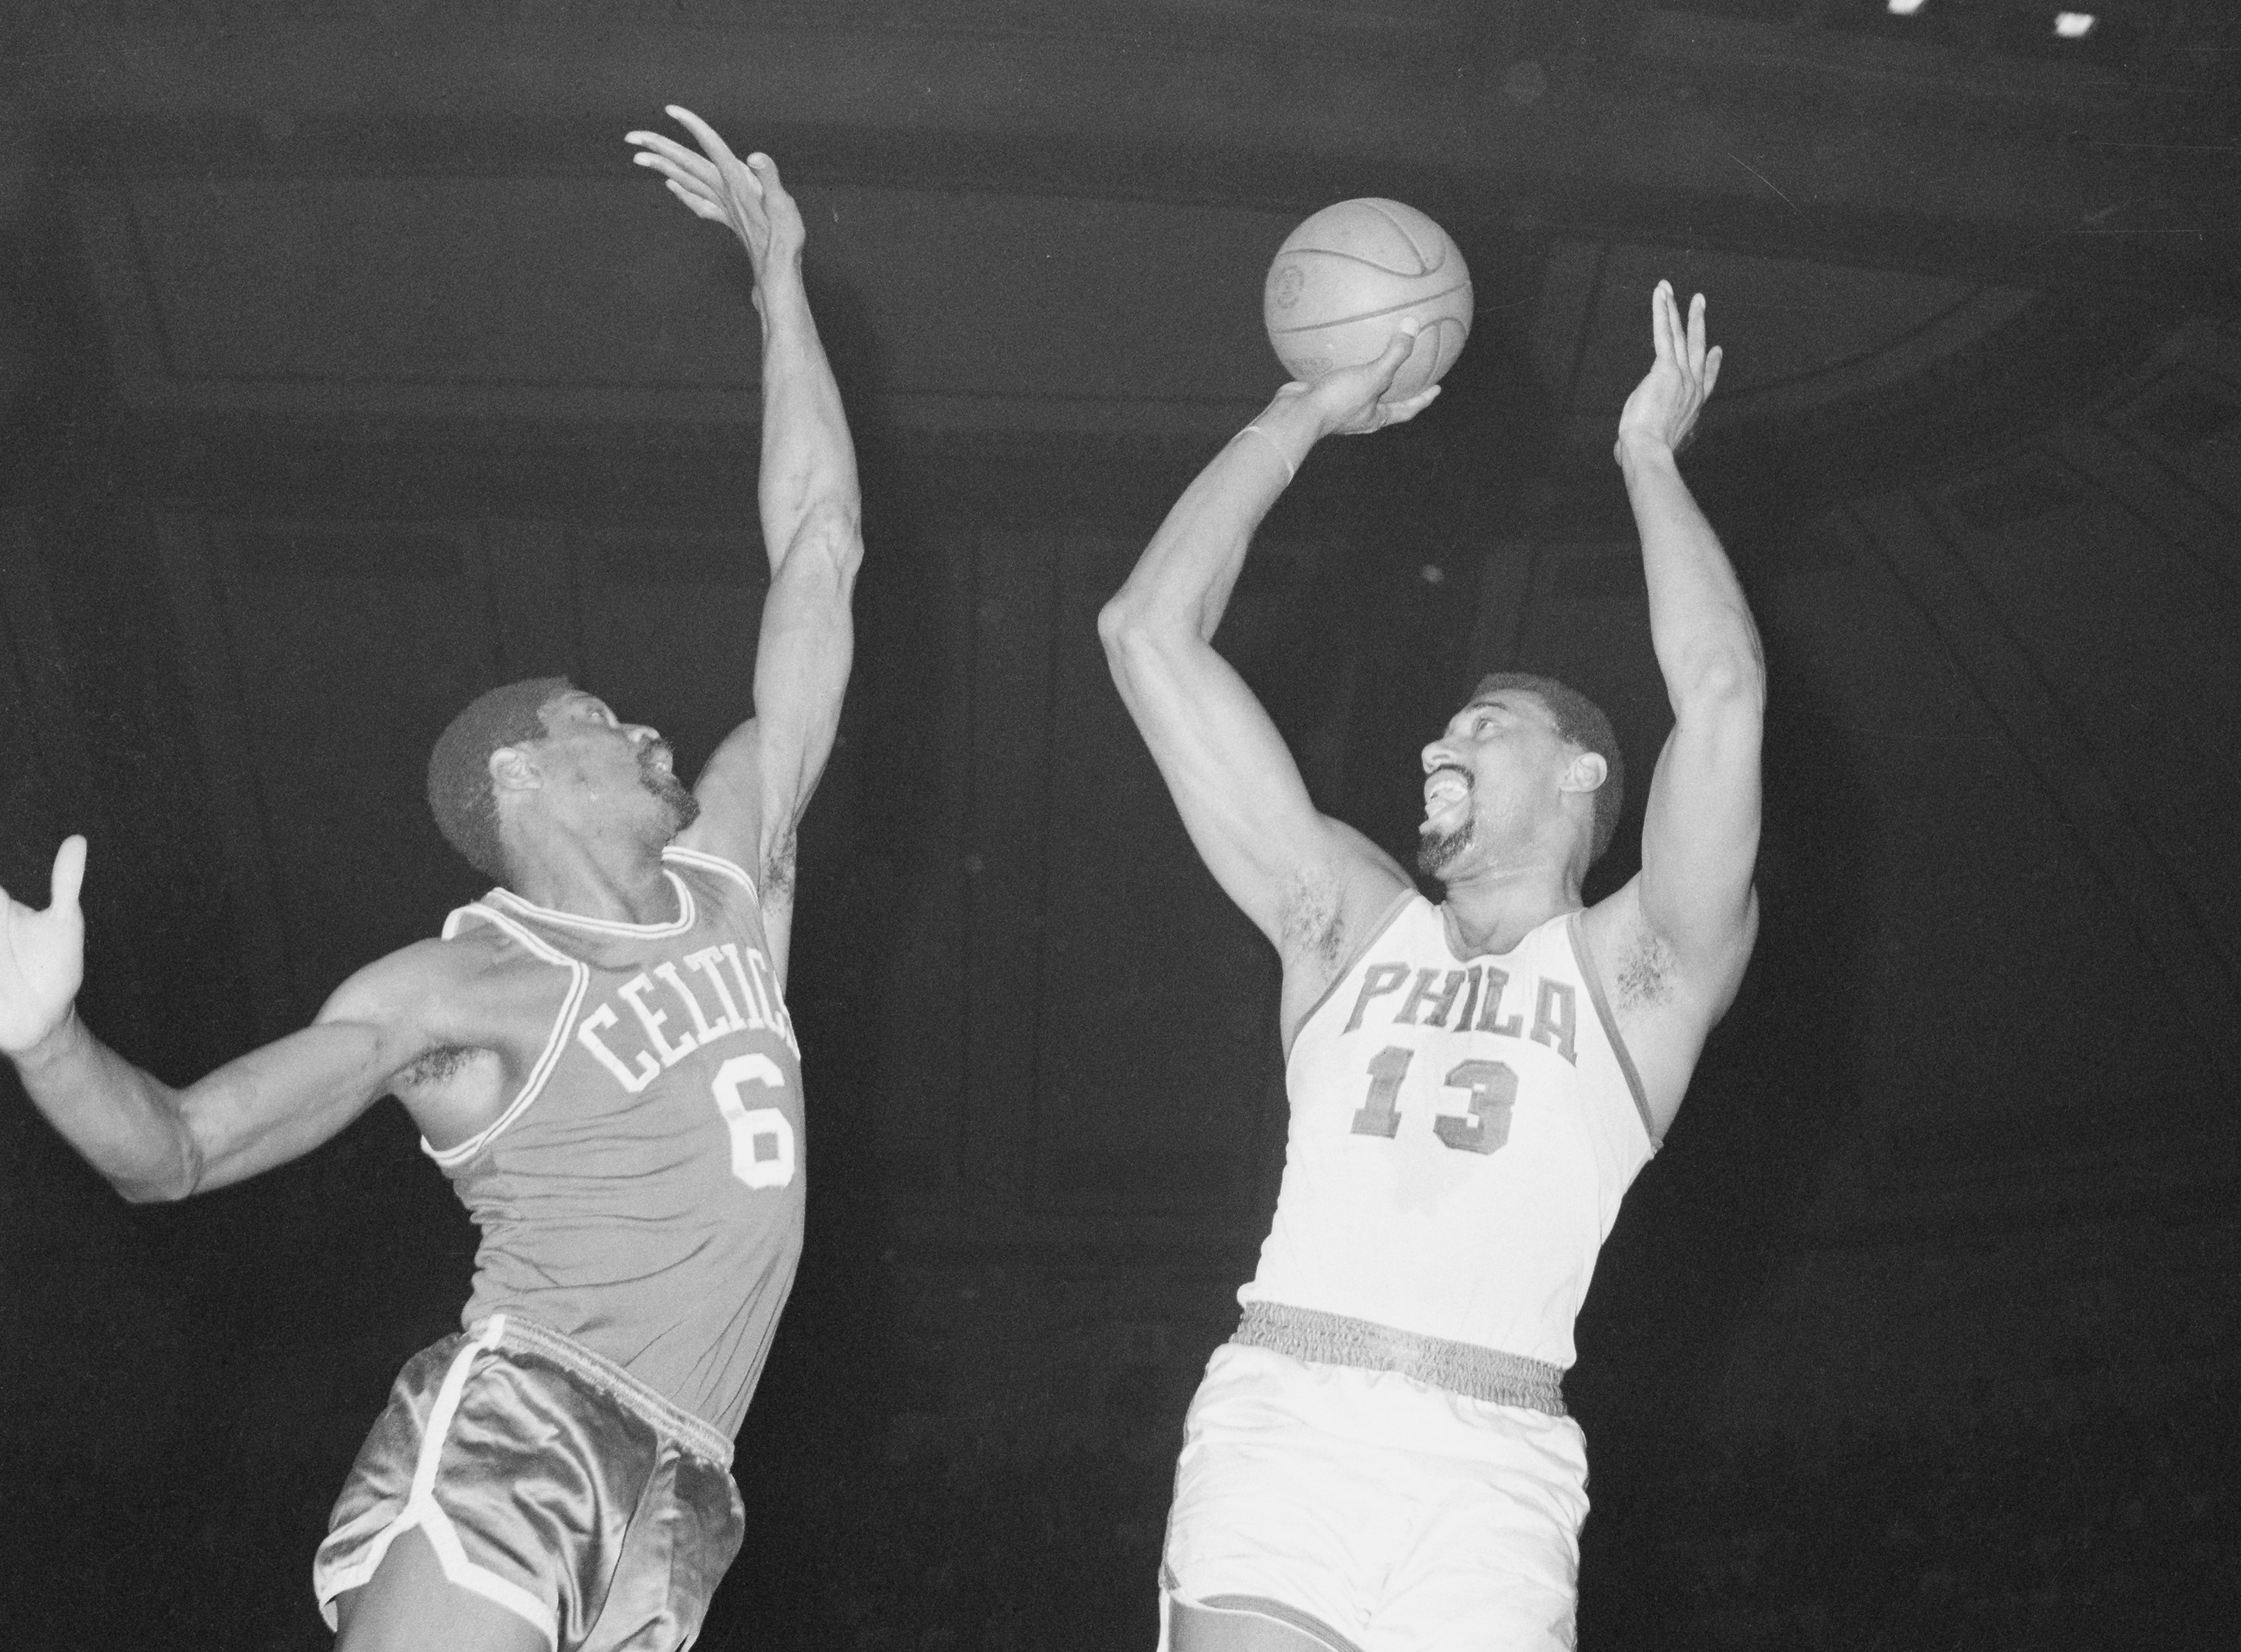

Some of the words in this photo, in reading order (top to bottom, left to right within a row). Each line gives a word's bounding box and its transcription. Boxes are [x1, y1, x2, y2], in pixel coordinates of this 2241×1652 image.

[1340, 961, 1578, 1068] PHILA
[712, 1053, 795, 1189] 6
[1350, 1045, 1519, 1156] 13
